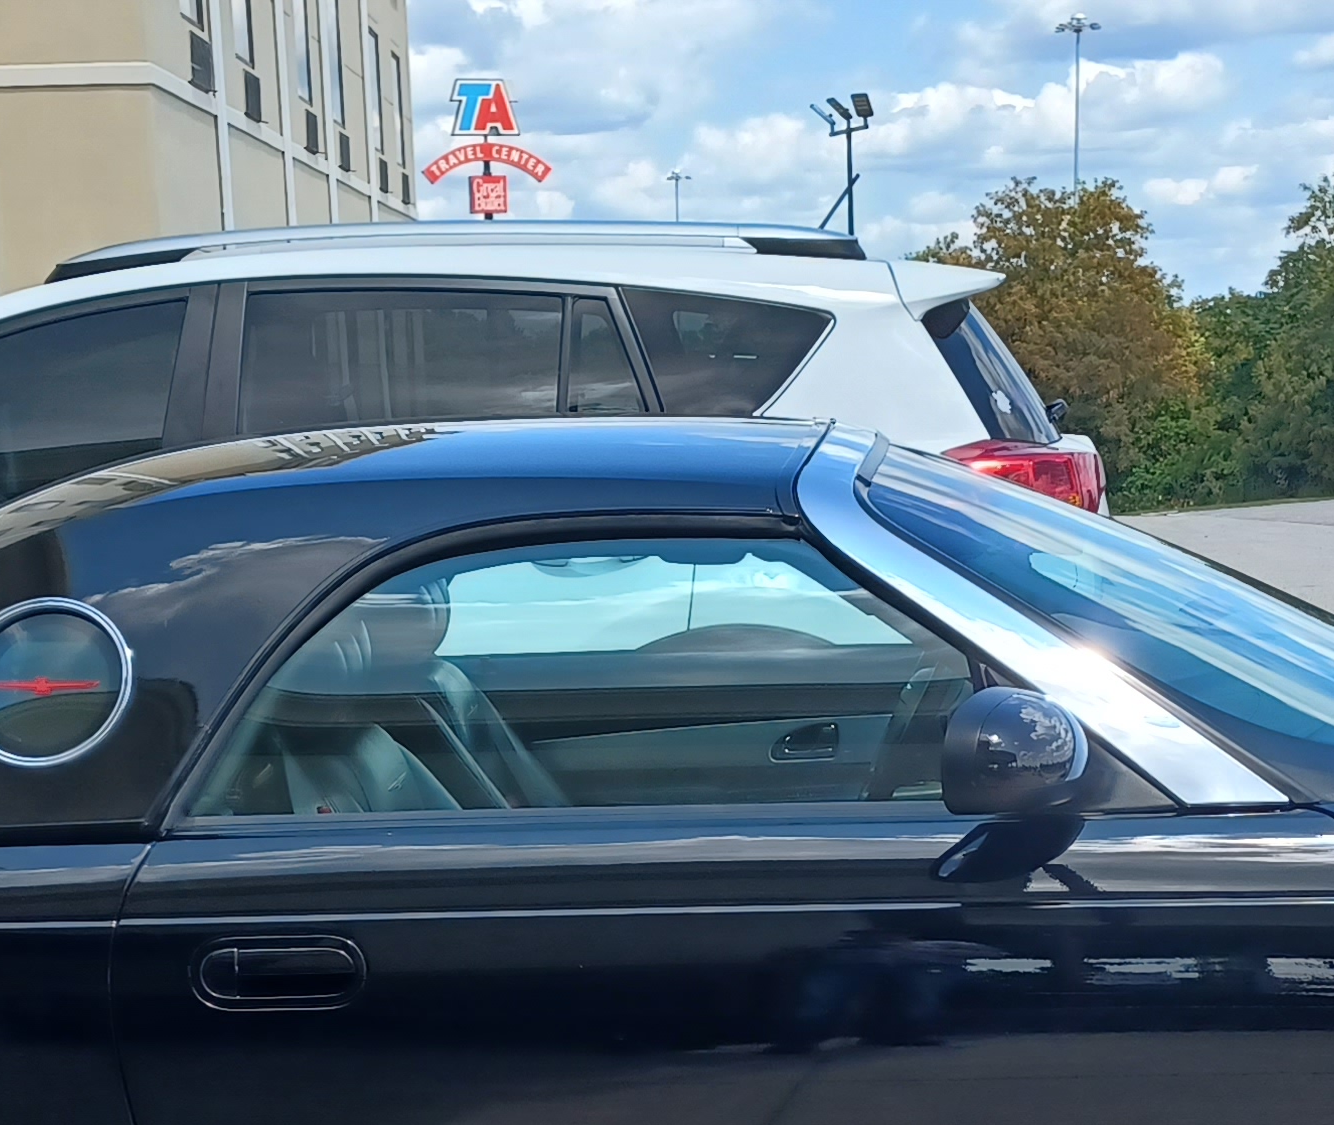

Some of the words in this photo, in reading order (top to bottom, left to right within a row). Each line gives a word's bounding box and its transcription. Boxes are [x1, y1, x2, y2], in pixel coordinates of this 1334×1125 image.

[457, 83, 515, 131] TA
[430, 146, 484, 177] TRAVEL
[492, 146, 545, 176] CENTER
